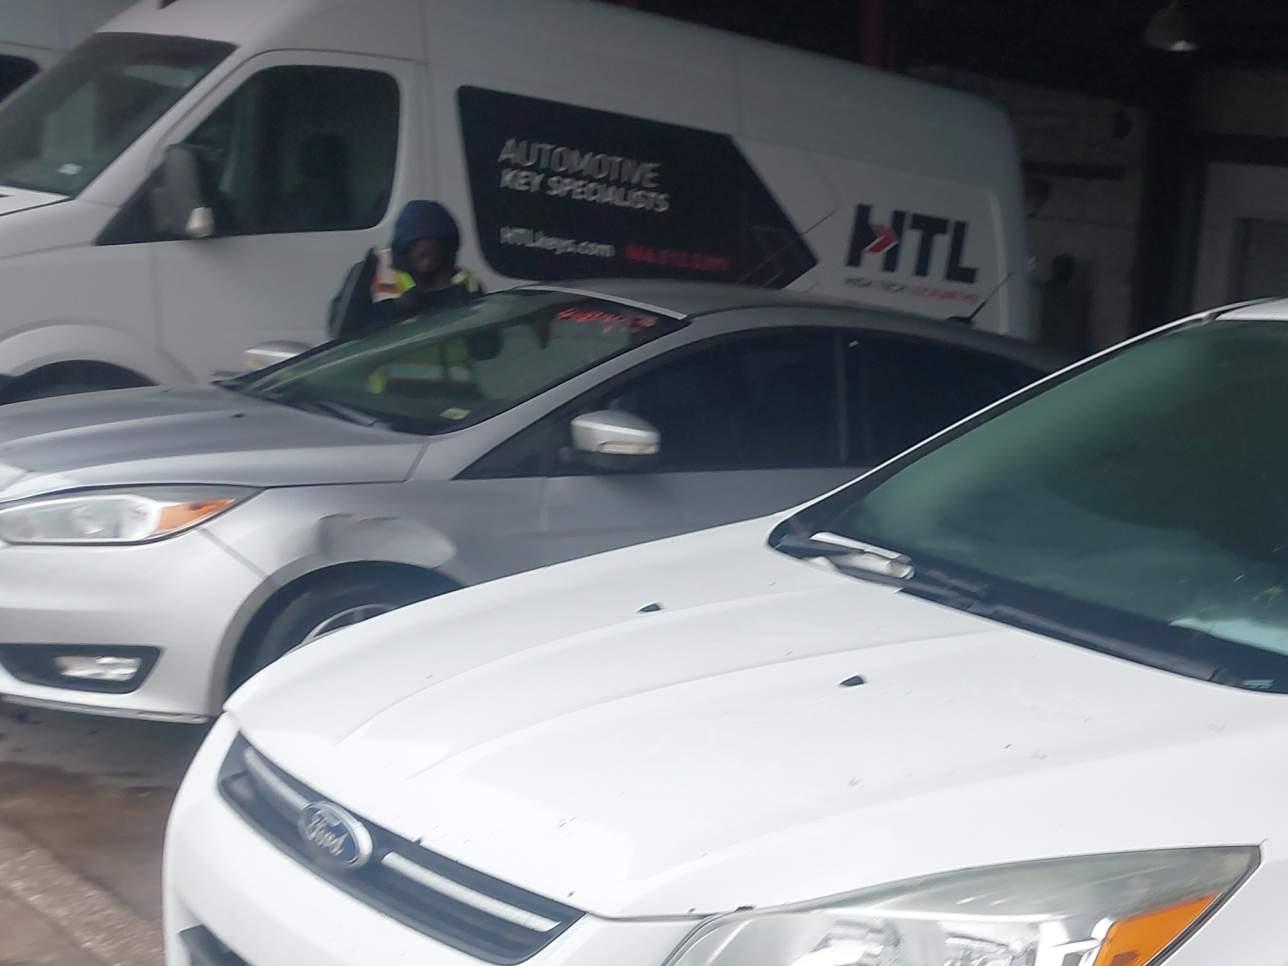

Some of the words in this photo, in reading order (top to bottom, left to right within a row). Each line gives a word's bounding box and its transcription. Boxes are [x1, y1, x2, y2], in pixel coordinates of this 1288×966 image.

[498, 137, 662, 188] AUTOMOTIVE
[500, 168, 544, 192] KEY
[545, 175, 672, 212] SPECIALISTS
[845, 203, 978, 284] HTL
[306, 808, 349, 857] Ford
